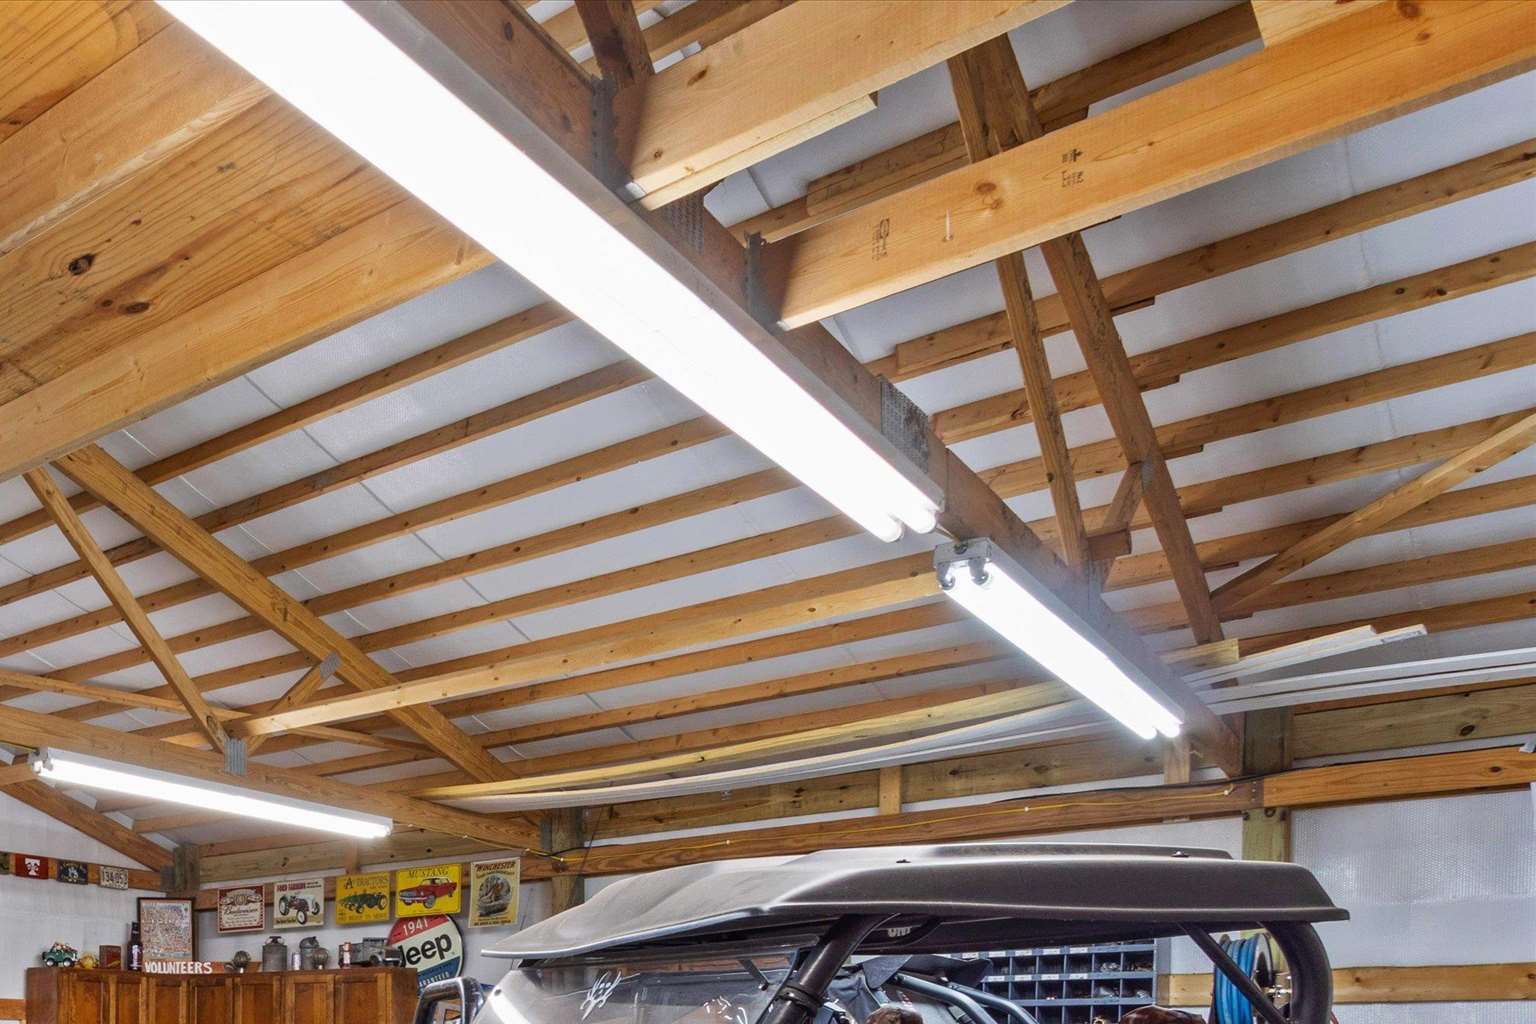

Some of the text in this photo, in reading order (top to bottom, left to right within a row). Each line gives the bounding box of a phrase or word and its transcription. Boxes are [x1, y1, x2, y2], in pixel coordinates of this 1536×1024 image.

[408, 865, 449, 878] MUSTANG
[475, 861, 516, 873] WINCHESTER
[403, 918, 429, 936] 1941
[144, 961, 213, 974] VOLUNTEERS
